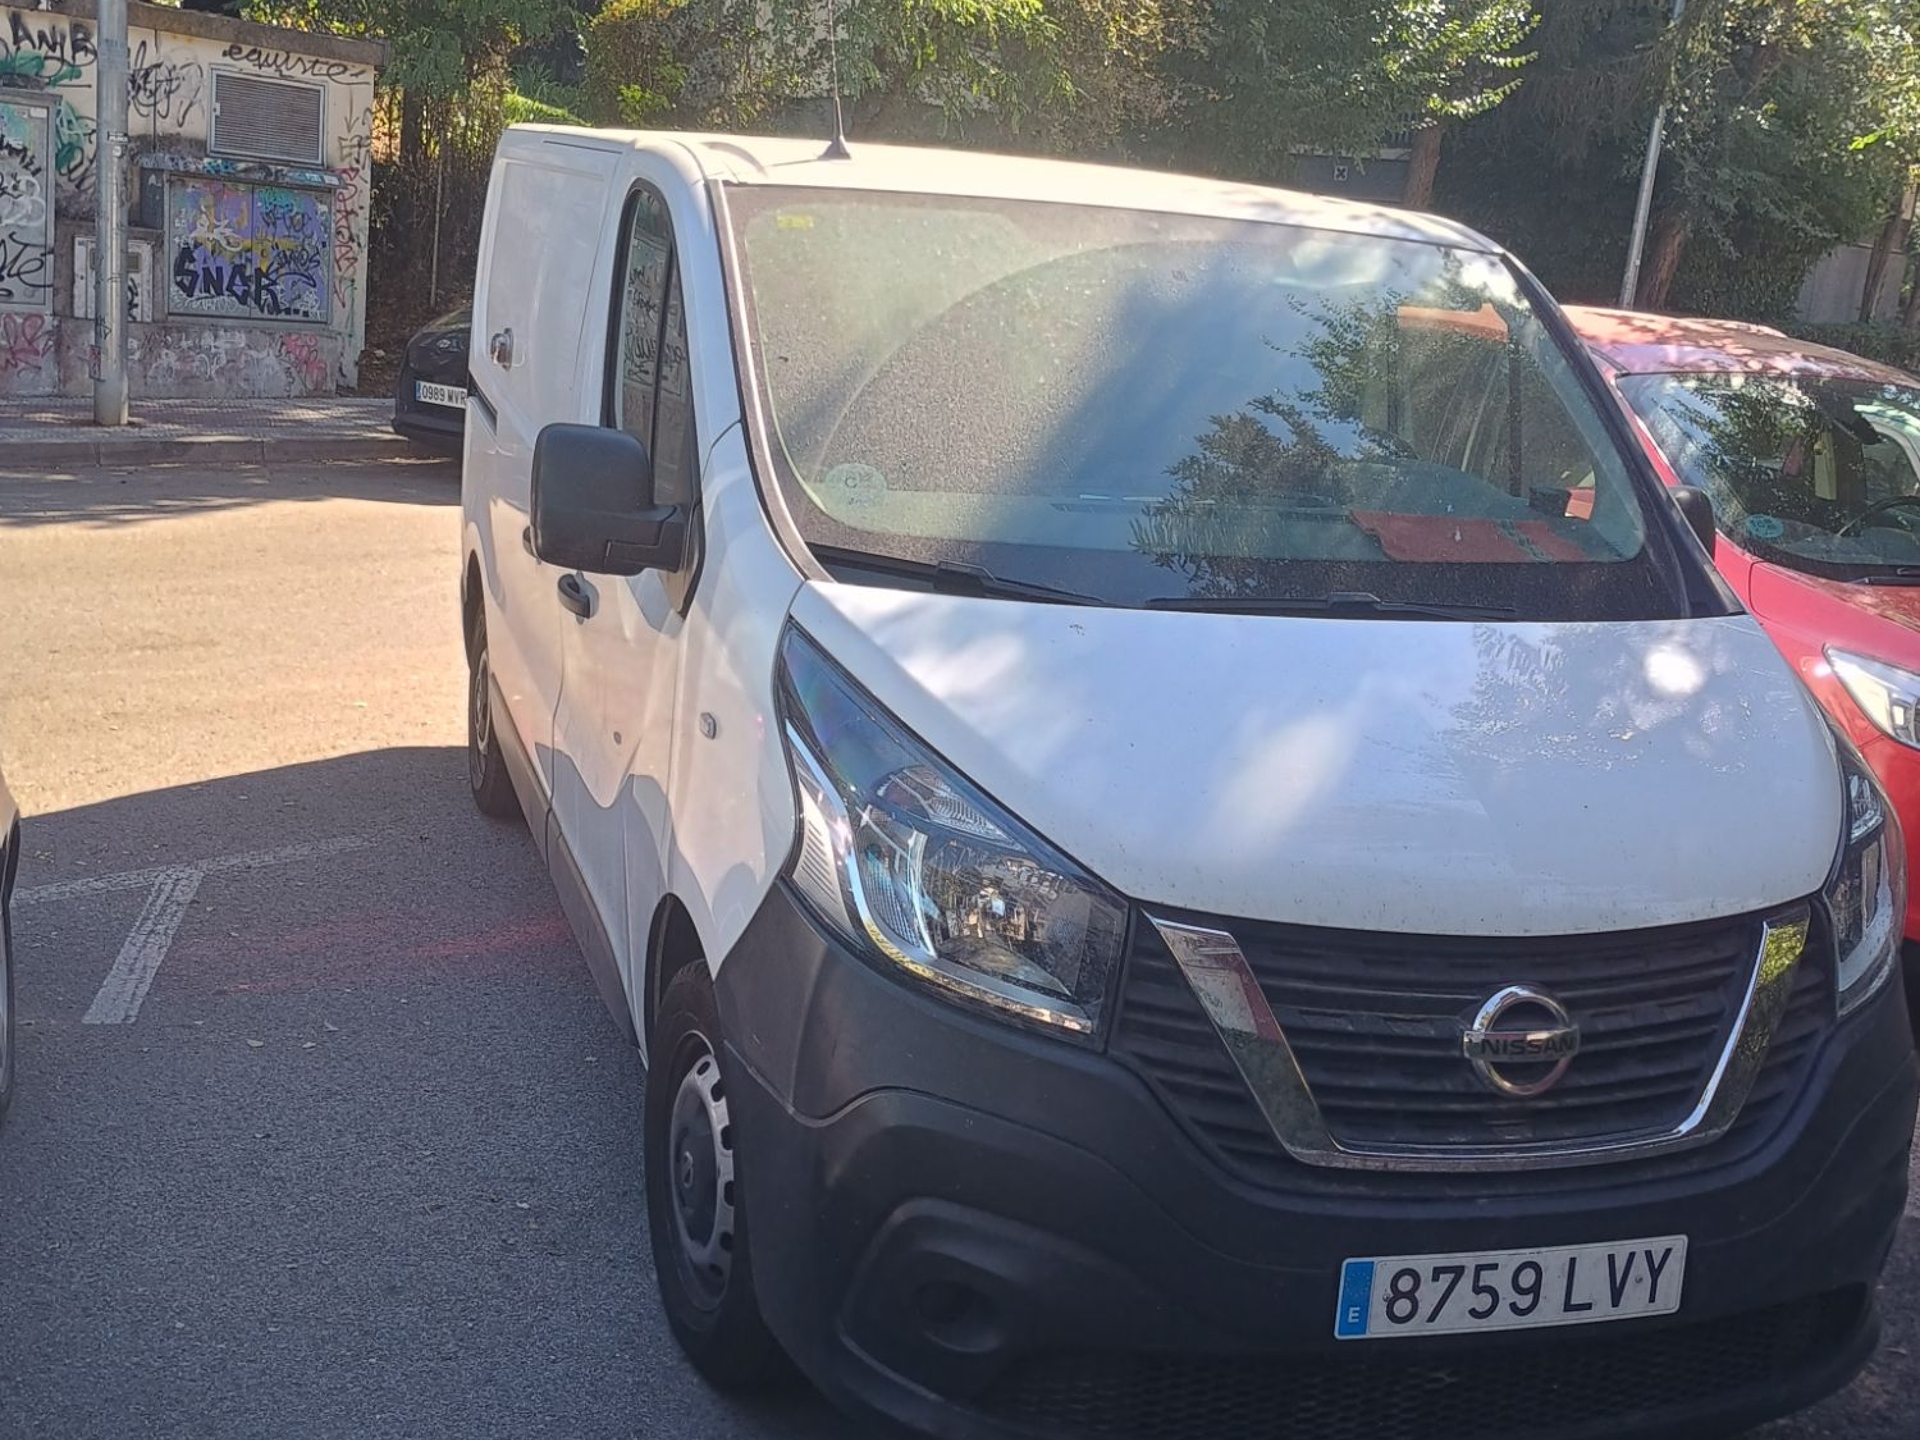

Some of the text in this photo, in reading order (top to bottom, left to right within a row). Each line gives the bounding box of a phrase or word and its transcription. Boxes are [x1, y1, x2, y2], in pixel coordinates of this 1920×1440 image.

[421, 384, 446, 402] 0989
[1481, 1030, 1573, 1055] NISSAN
[1385, 1248, 1673, 1325] 8759 LVY
[1347, 1307, 1360, 1323] E
